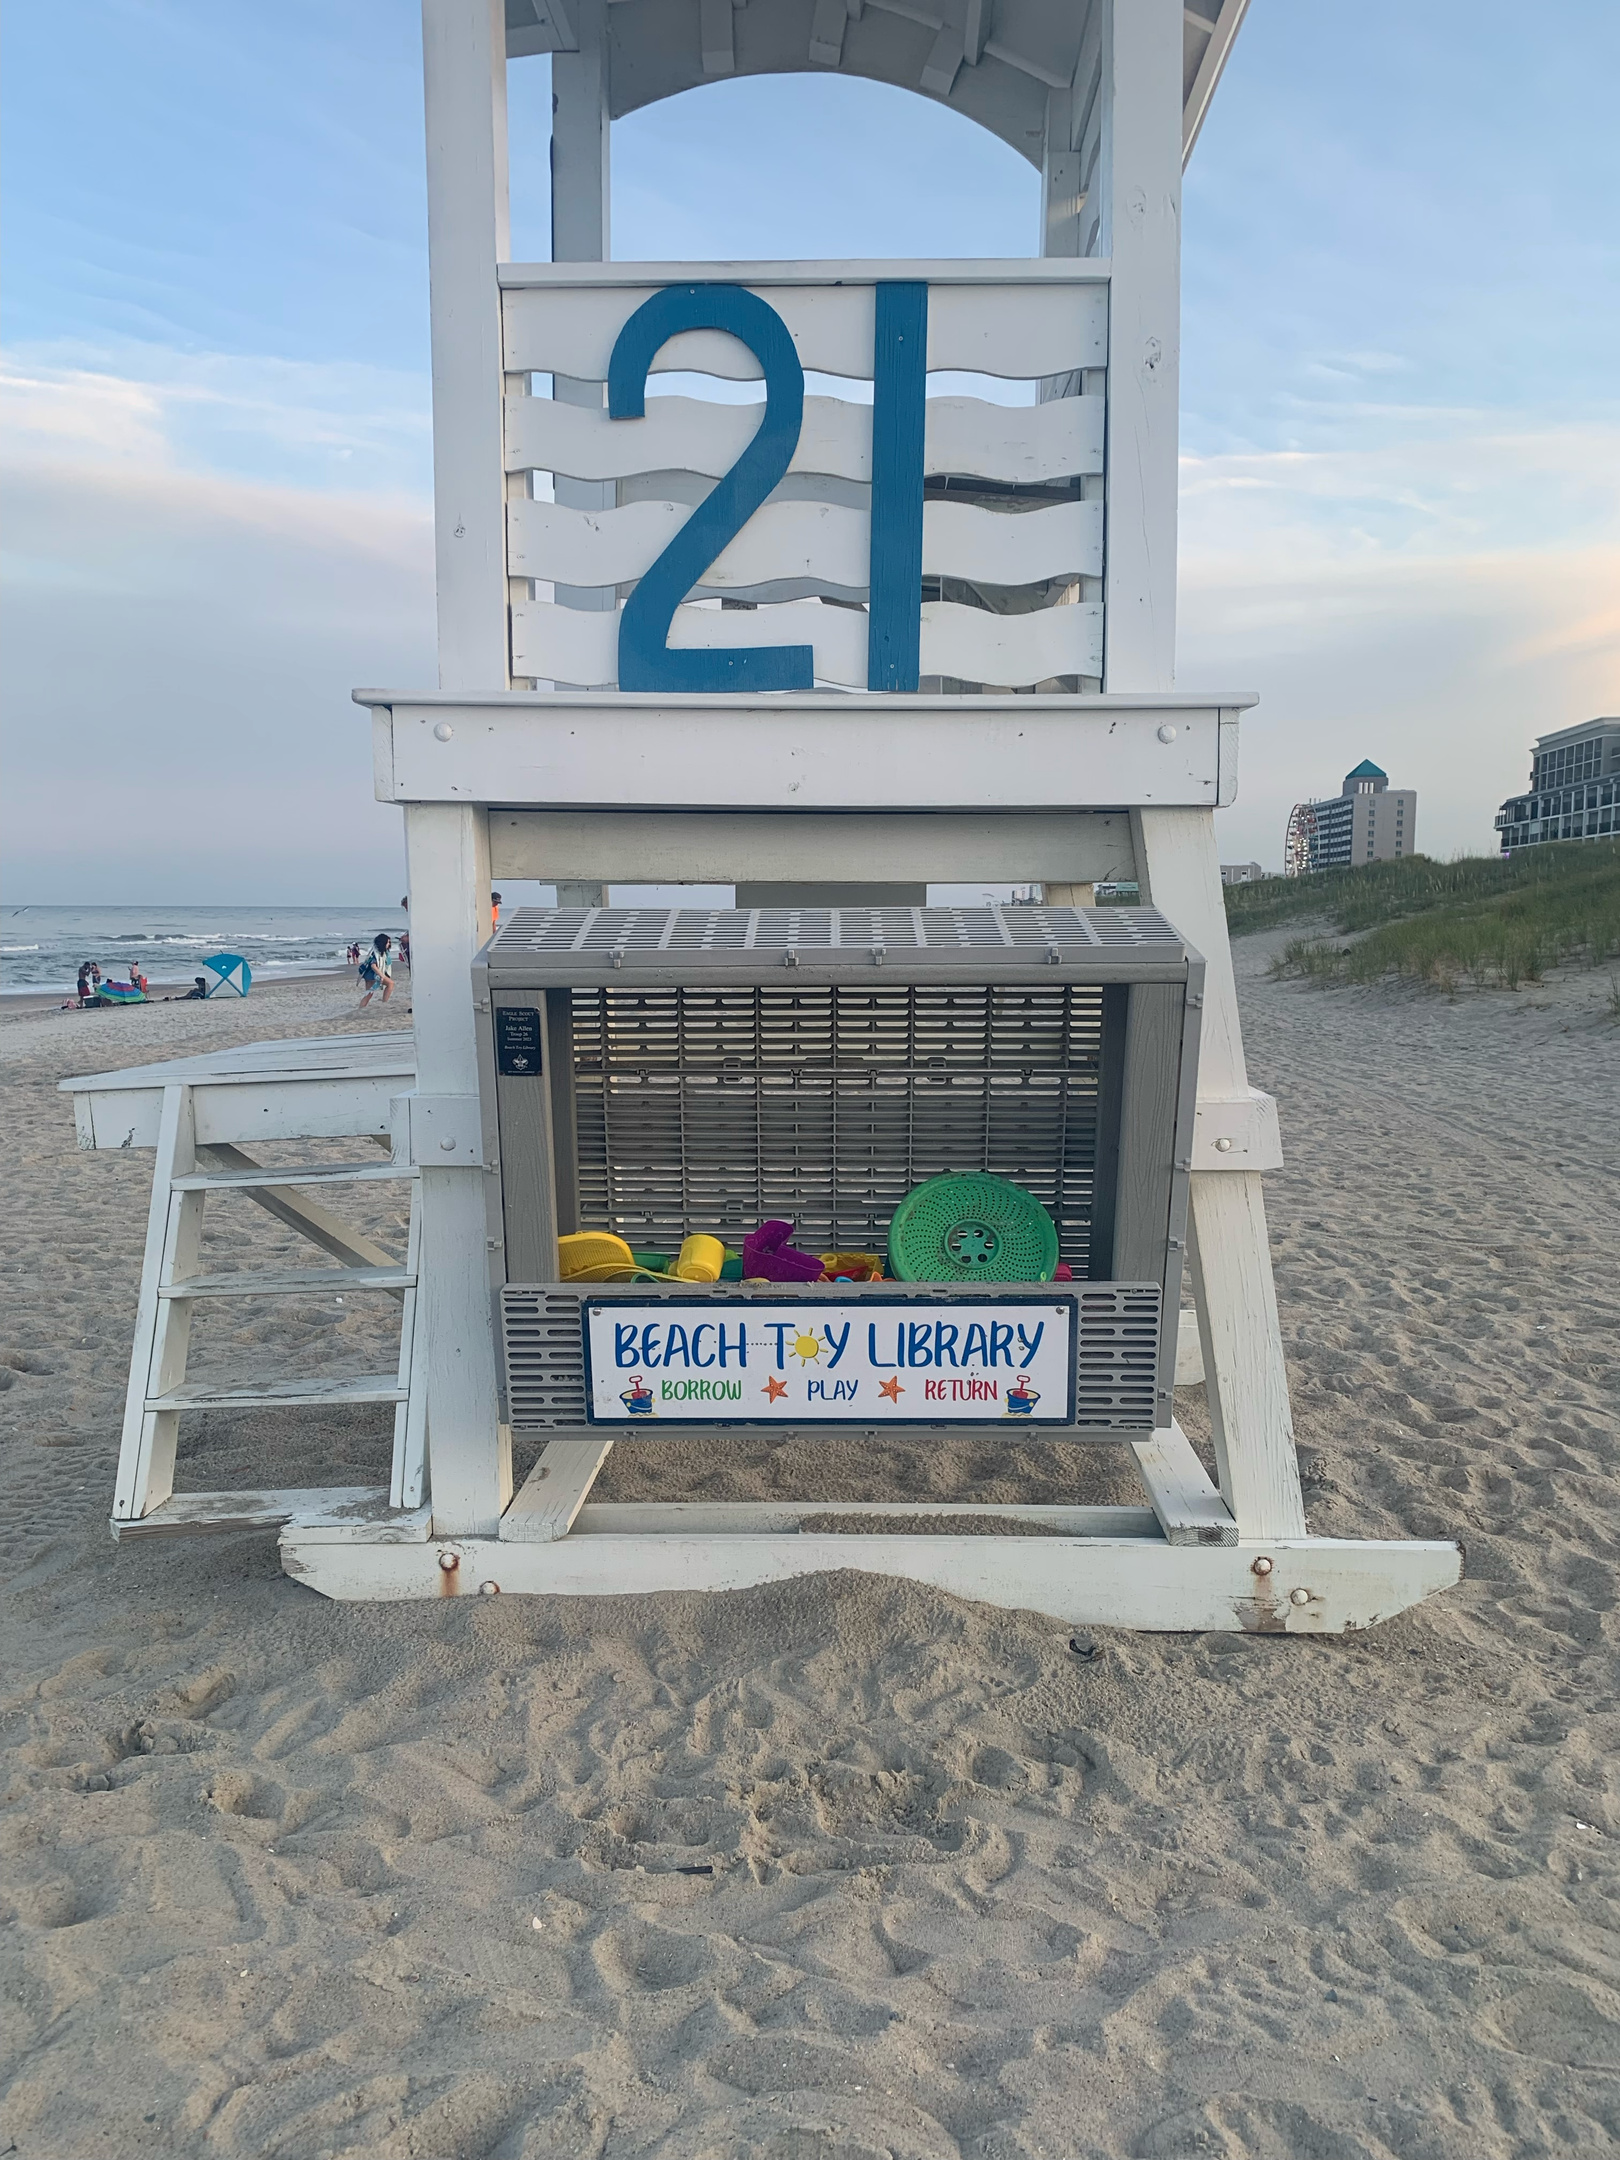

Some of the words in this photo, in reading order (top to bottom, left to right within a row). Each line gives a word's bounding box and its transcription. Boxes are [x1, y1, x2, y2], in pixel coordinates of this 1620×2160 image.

[608, 282, 929, 692] 21
[615, 1322, 747, 1368] BEACH
[868, 1320, 1045, 1368] LIBRARY
[661, 1379, 742, 1400] BORROW
[807, 1379, 859, 1401] PLAY
[925, 1379, 998, 1401] RETURN
